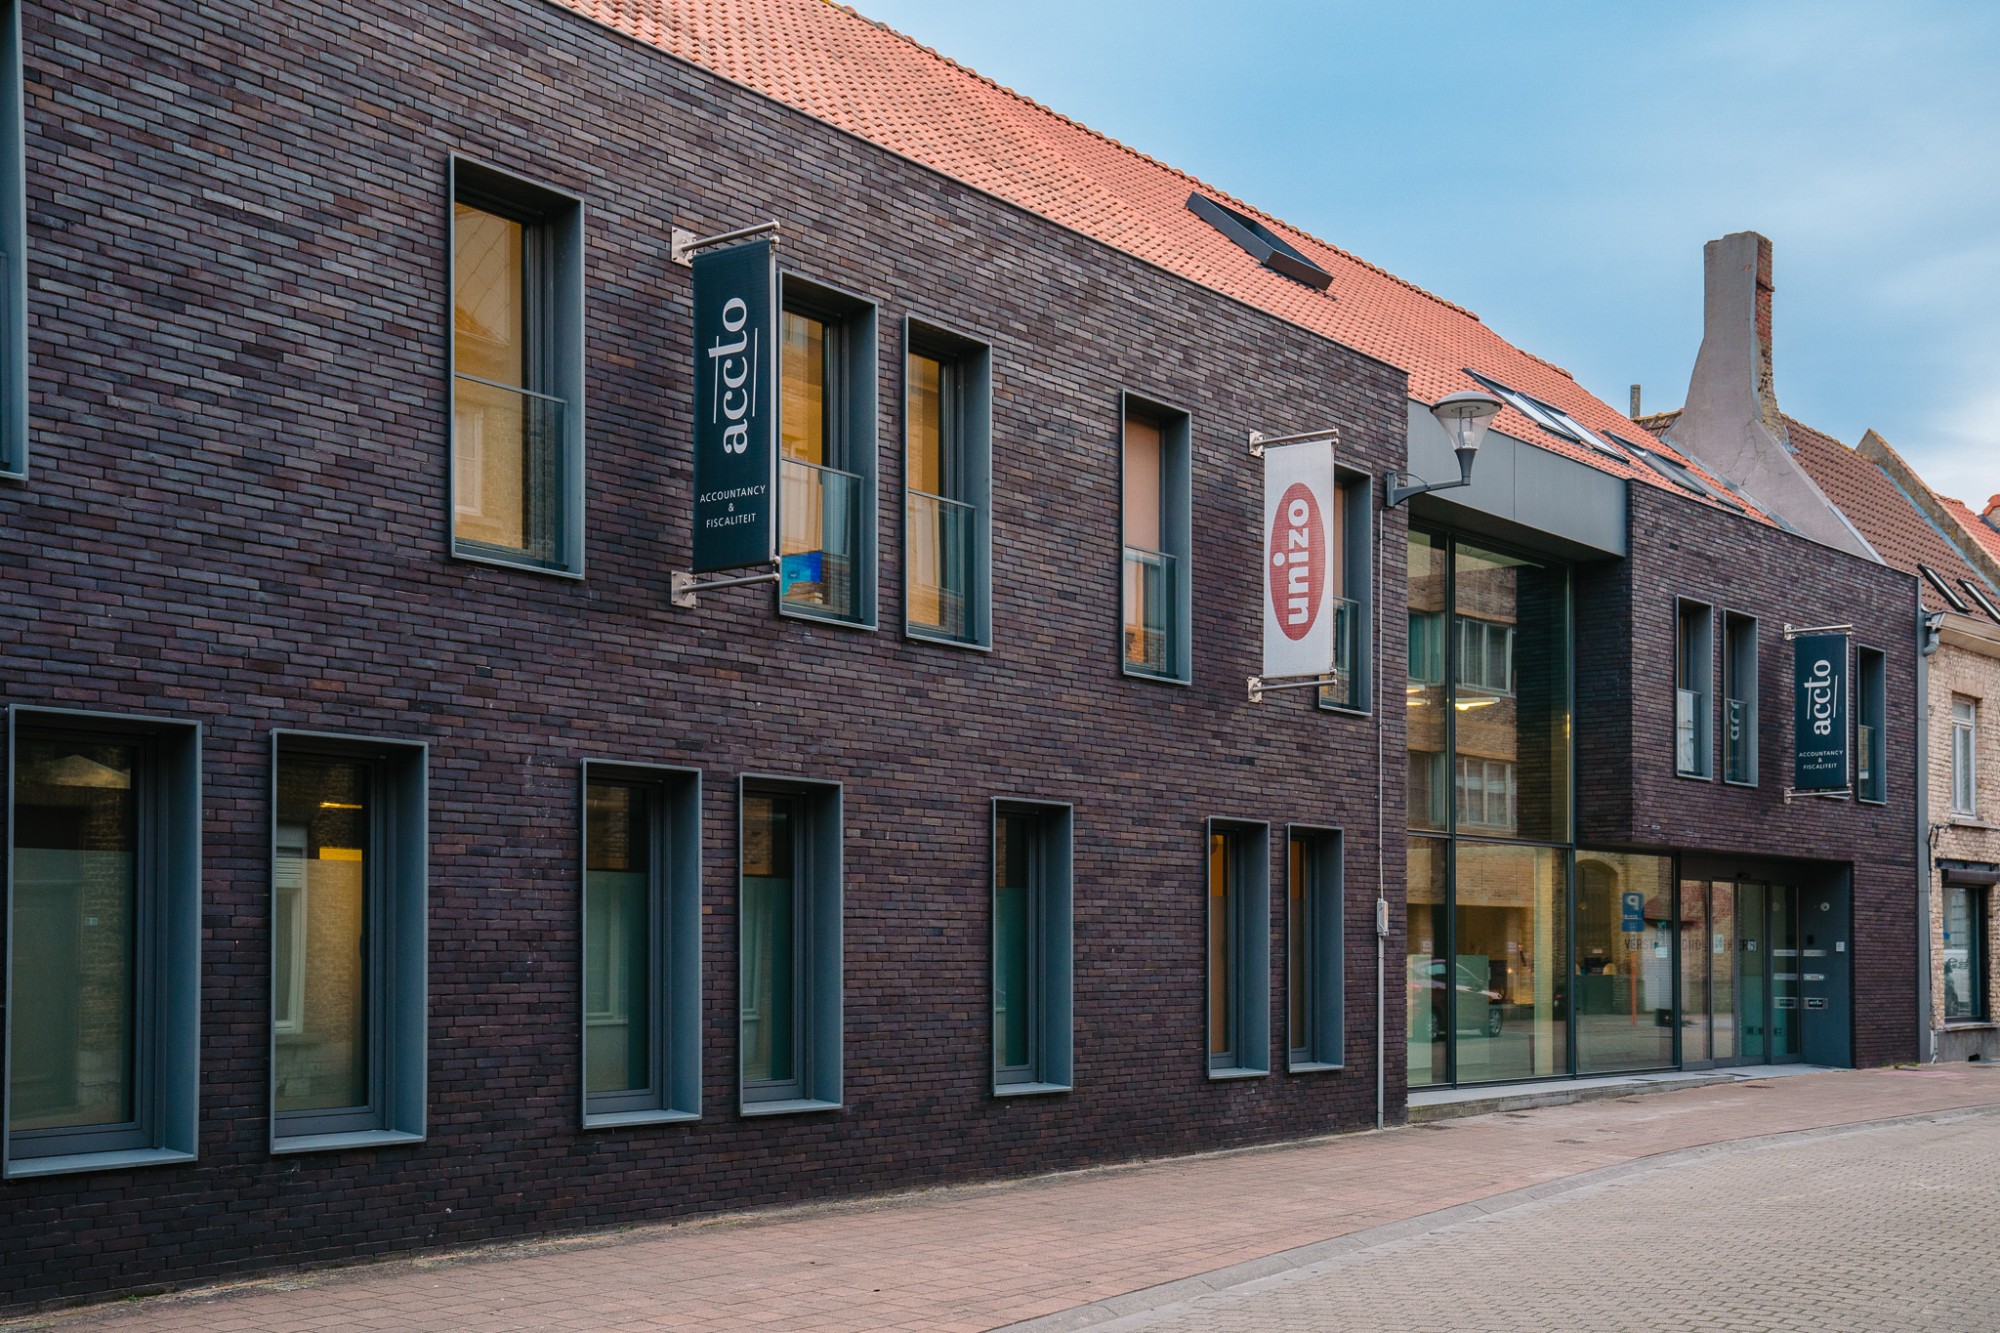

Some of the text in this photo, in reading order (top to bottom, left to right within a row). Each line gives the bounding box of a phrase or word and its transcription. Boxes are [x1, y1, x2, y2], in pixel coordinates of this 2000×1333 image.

[708, 297, 748, 454] accto
[699, 484, 766, 503] ACCOUNTANCY
[728, 502, 736, 512] &
[706, 513, 757, 528] FISCALITEIT
[1273, 498, 1310, 625] unizo
[1804, 659, 1831, 736] accto
[1799, 750, 1844, 758] ACCOUNTANCY
